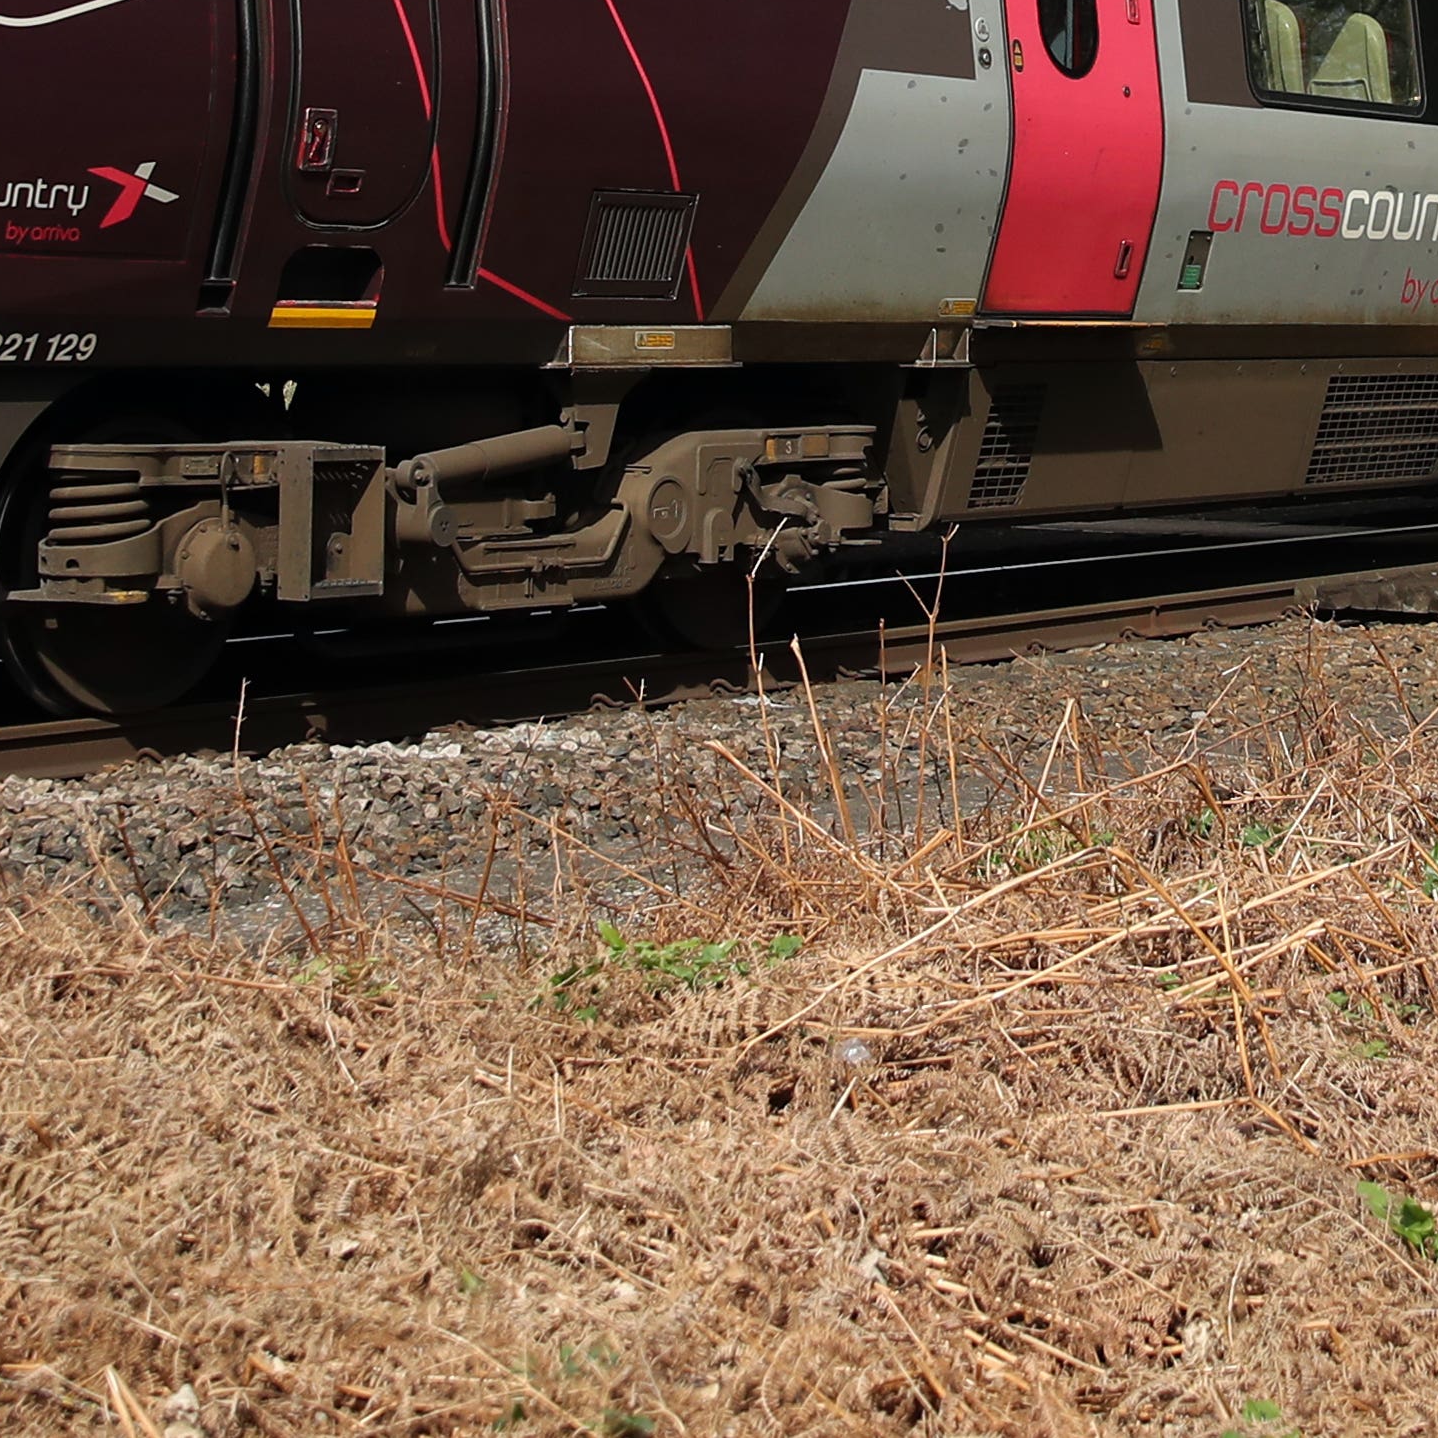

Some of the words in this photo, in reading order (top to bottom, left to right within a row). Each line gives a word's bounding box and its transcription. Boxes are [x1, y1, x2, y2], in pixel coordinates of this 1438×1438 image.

[5, 220, 29, 245] by
[30, 223, 81, 243] arriva
[1400, 266, 1429, 314] by
[45, 333, 99, 363] 129
[785, 440, 793, 455] 3
